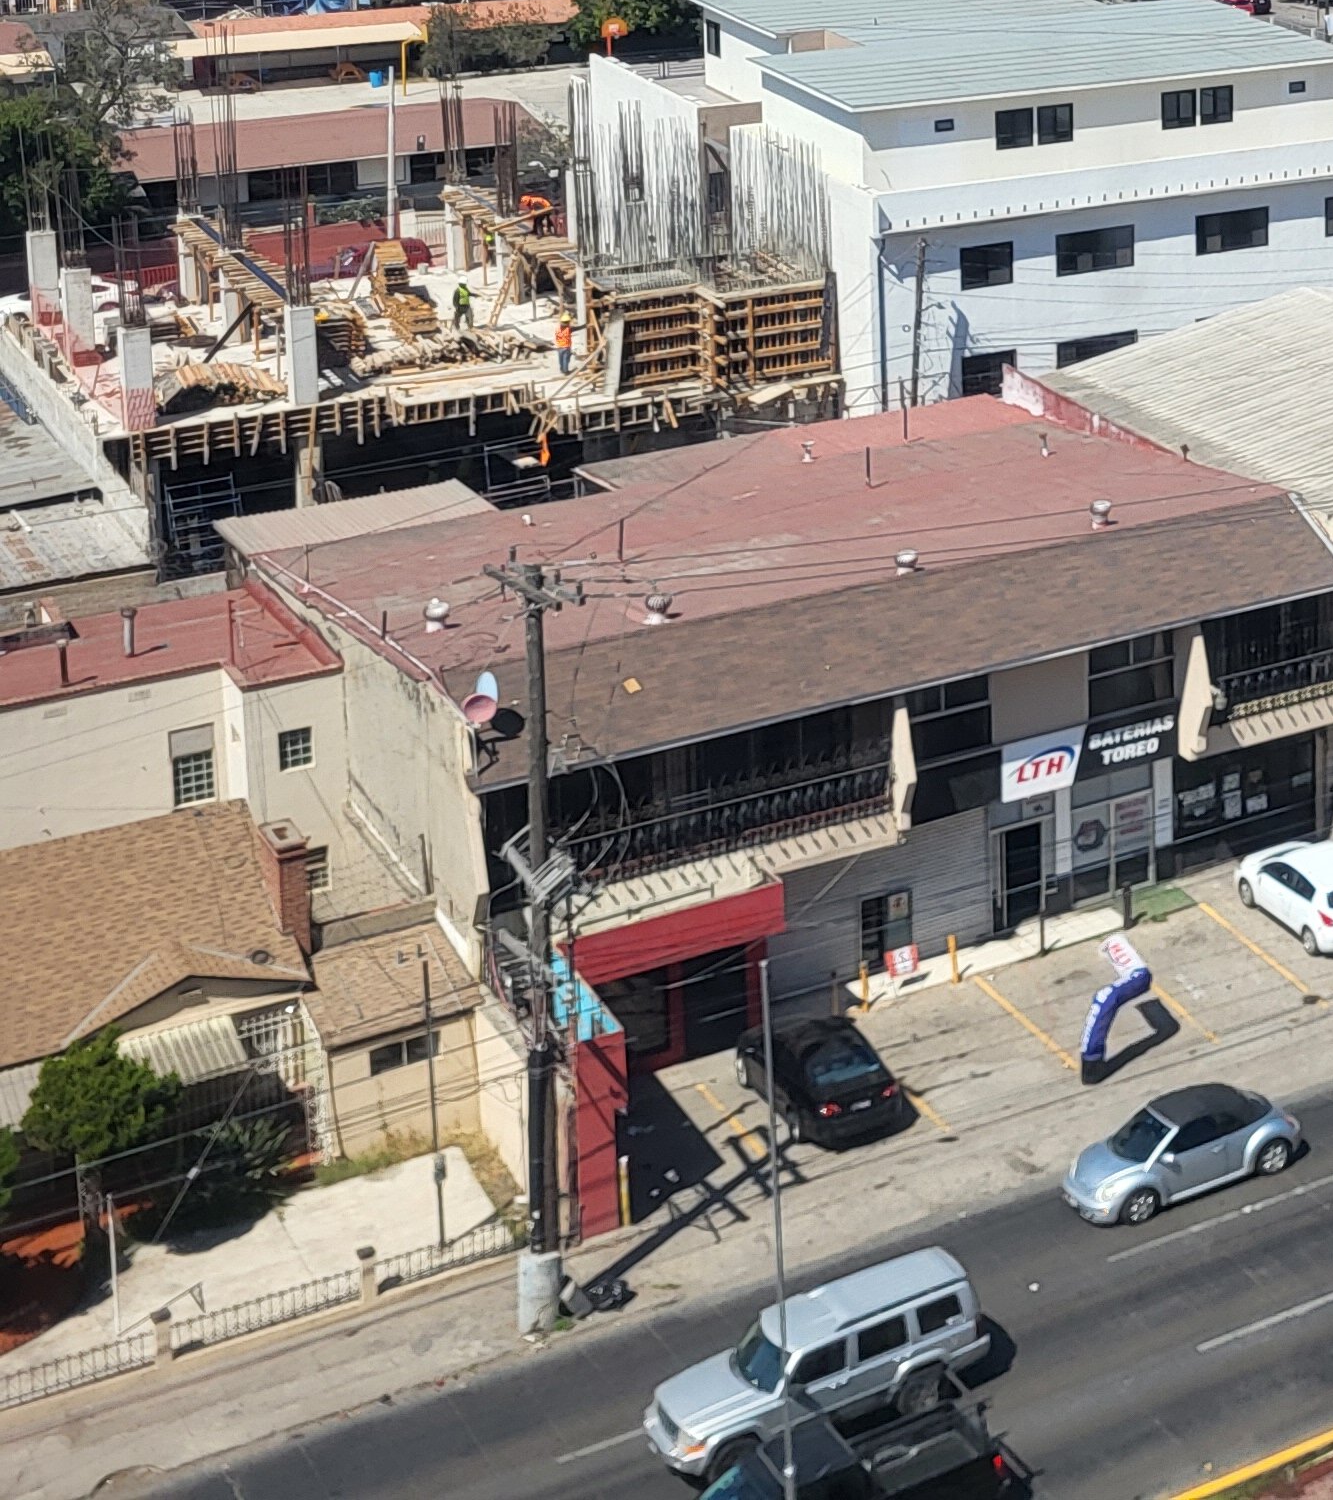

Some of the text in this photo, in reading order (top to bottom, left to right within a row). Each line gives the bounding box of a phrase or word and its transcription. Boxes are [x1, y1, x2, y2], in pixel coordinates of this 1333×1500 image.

[1088, 714, 1176, 751] BATERIAS
[1101, 737, 1161, 766] TOREO
[1016, 755, 1066, 785] LTH
